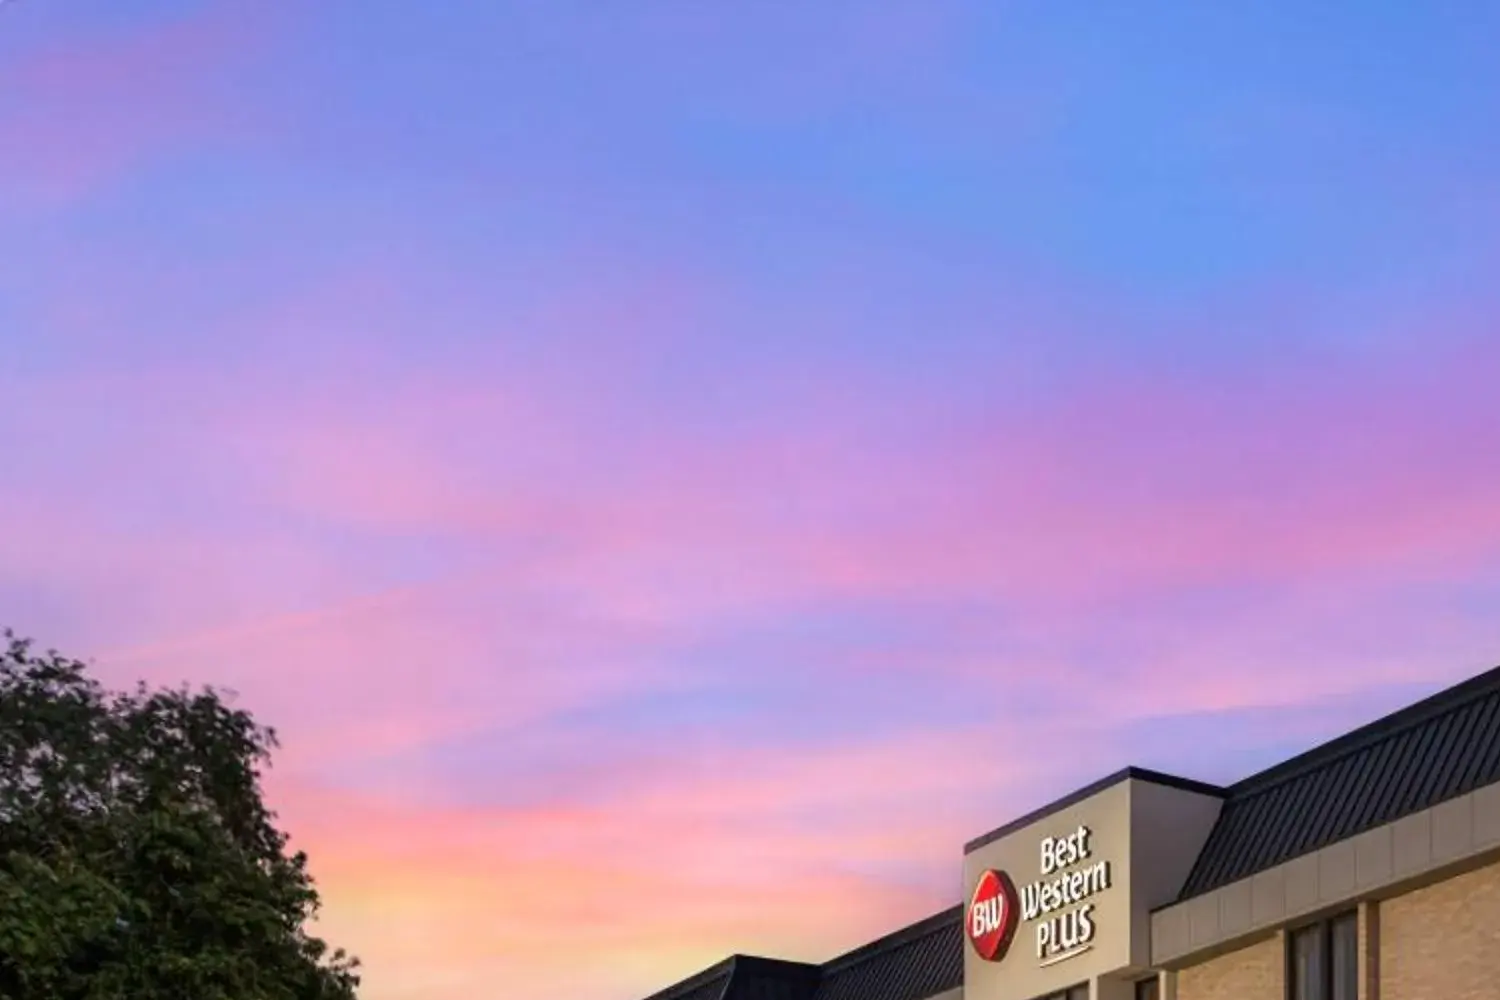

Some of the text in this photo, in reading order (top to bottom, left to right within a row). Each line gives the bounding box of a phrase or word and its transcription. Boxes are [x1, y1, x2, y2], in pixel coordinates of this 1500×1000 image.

[1041, 825, 1087, 874] Best
[973, 893, 1003, 938] BW
[1021, 861, 1107, 920] Western
[1037, 904, 1091, 958] PLUS
